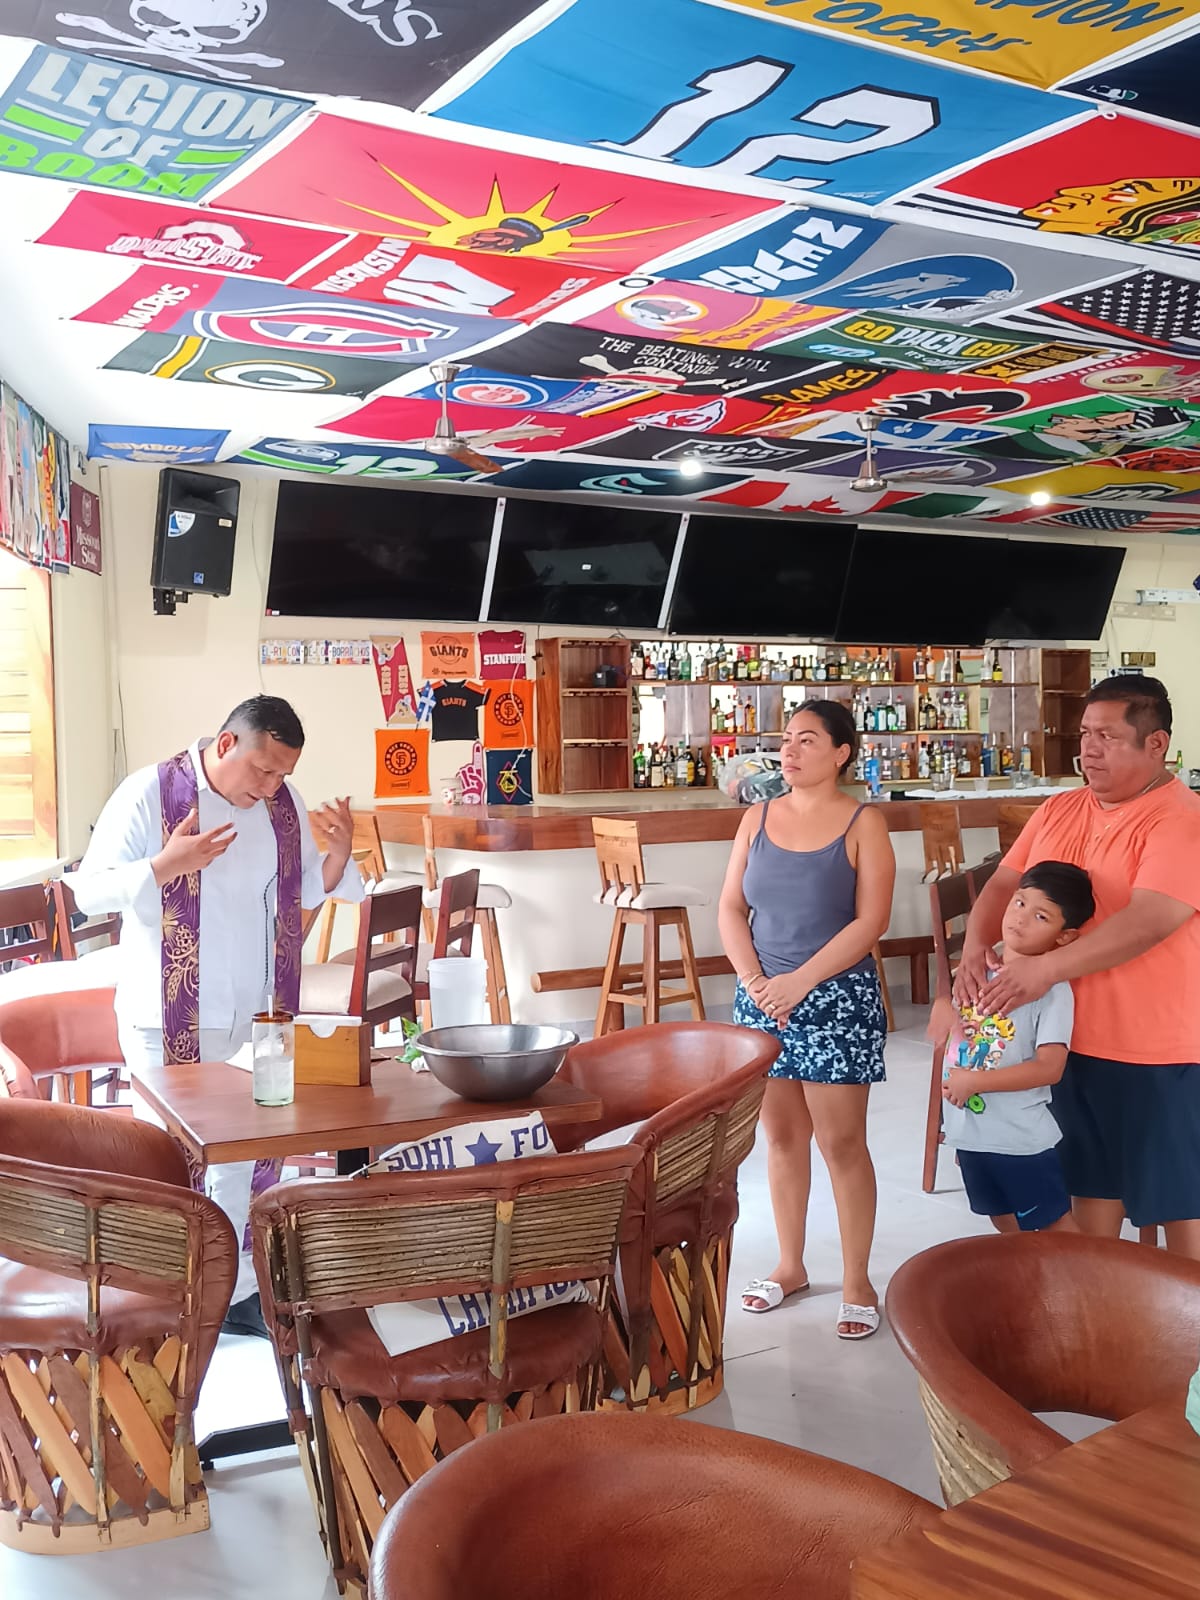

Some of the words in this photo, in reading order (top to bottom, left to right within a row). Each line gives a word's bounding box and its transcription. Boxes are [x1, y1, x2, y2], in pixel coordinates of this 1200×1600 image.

[26, 53, 303, 142] LEGION
[578, 54, 942, 191] 12
[81, 126, 181, 168] OF
[0, 134, 220, 198] BOOM
[676, 216, 864, 297] NEVAD
[599, 336, 636, 354] THE
[637, 344, 721, 366] BEATINGS
[843, 320, 896, 341] GO
[883, 327, 978, 355] PACK
[961, 341, 1021, 357] GO!
[633, 355, 719, 375] CONTINUE
[429, 644, 469, 659] GIANTS
[483, 653, 526, 665] STANFORD
[441, 697, 467, 708] GIANTS
